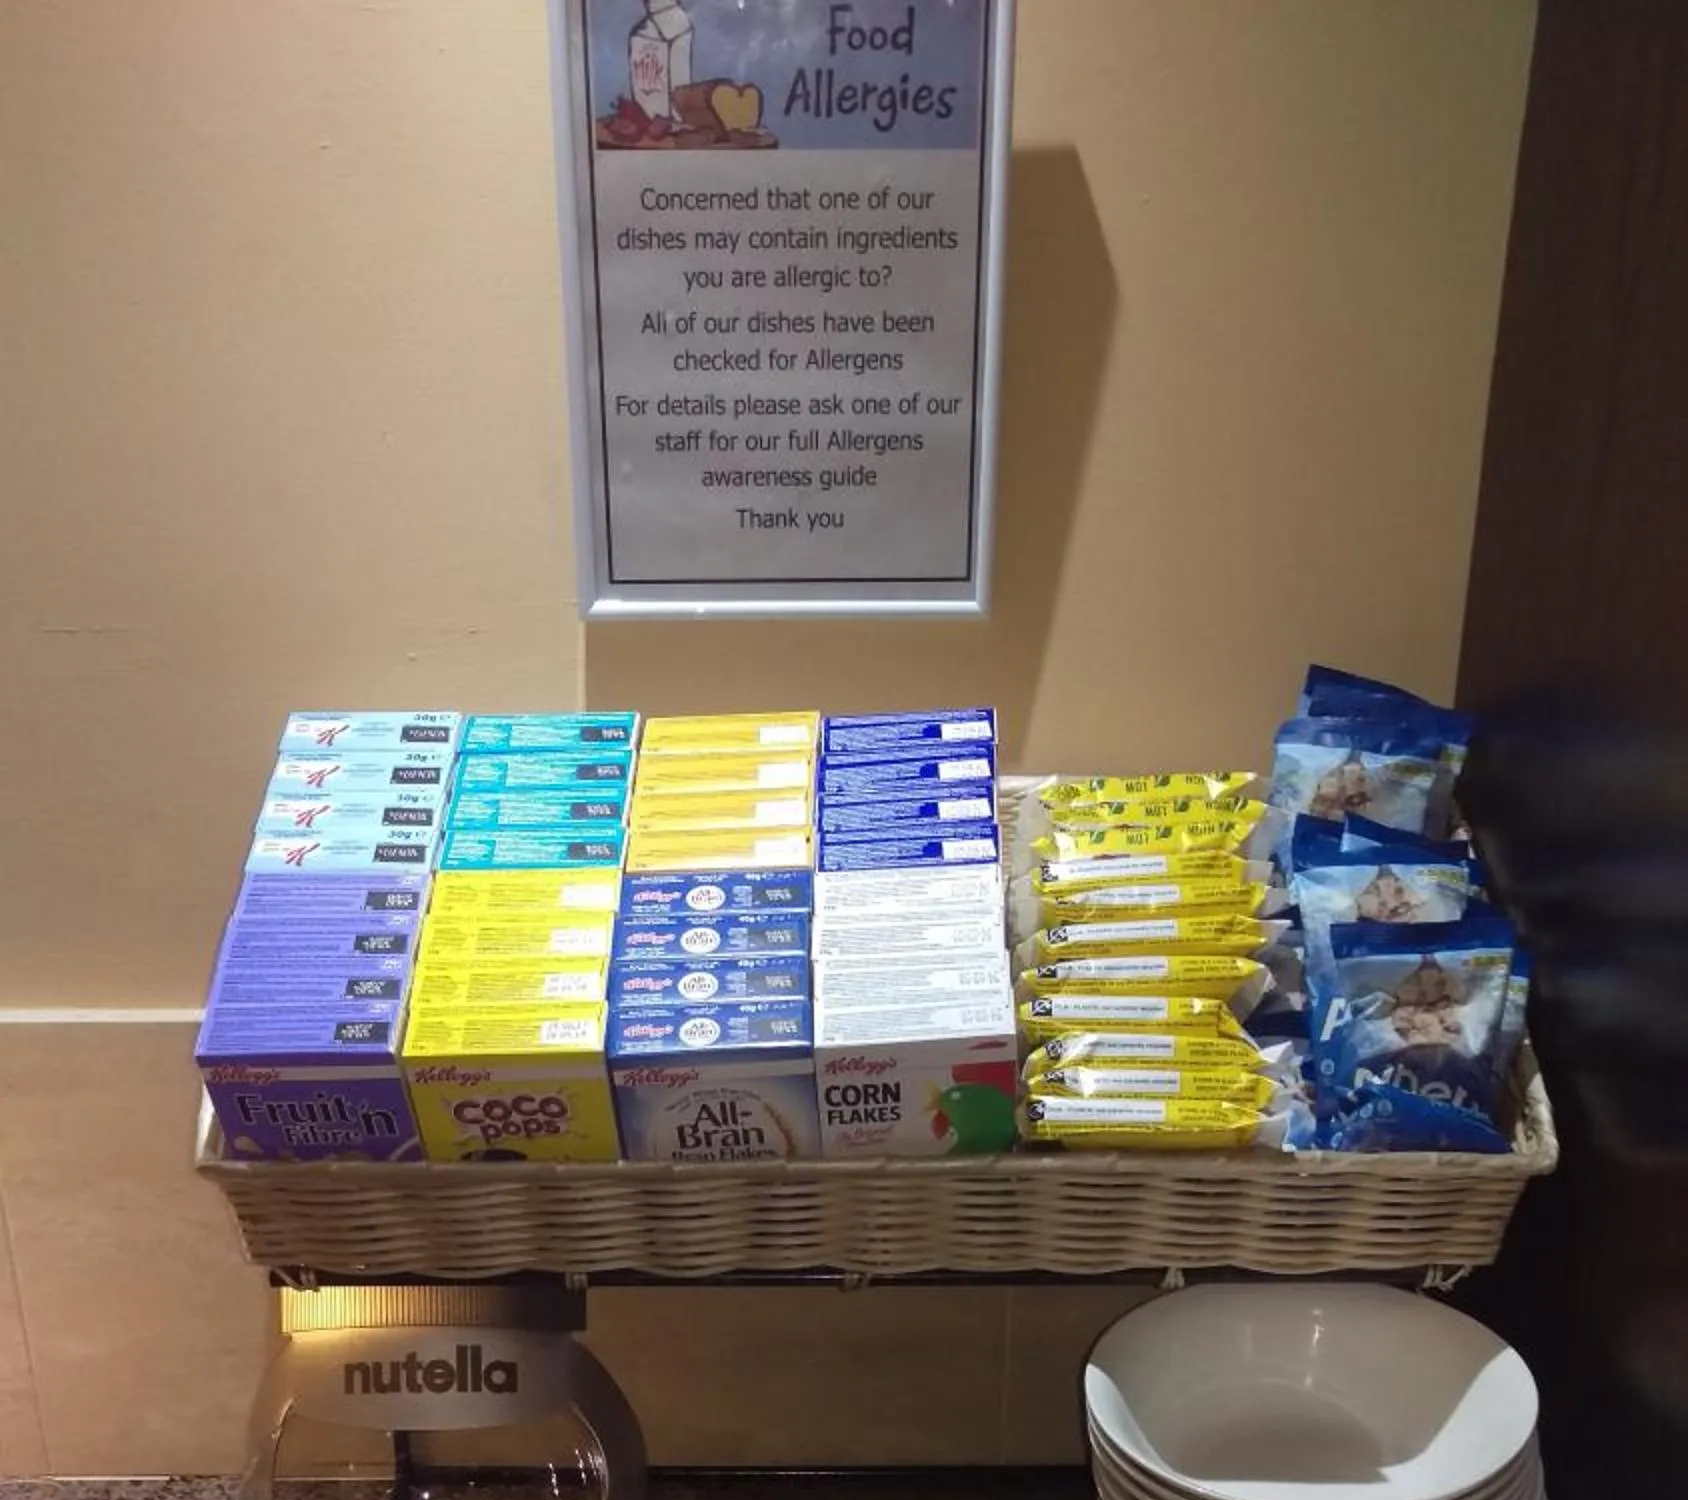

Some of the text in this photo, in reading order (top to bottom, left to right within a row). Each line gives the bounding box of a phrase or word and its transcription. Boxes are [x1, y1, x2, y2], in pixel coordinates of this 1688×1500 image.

[827, 3, 916, 56] Food
[783, 67, 957, 133] Allergies
[639, 185, 935, 212] Concerned that one of our
[616, 225, 959, 255] dishes may contain ingredients
[682, 264, 893, 294] you are allergic to?
[640, 310, 935, 335] All of our dishes have been
[673, 348, 904, 376] checked for Allergens
[615, 392, 962, 420] For details please ask one of our
[655, 429, 924, 457] staff for our full Allergens
[701, 465, 878, 491] awareness guide
[735, 507, 845, 533] Thank you
[415, 1065, 491, 1086] Kellogg's
[623, 1068, 700, 1088] Kellogg's
[824, 1056, 897, 1075] Kellogg's
[824, 1081, 901, 1107] CORN
[234, 1092, 351, 1124] Fruit
[695, 1101, 752, 1127] All-
[827, 1106, 901, 1125] FLAKES
[480, 1118, 560, 1144] pops
[676, 1123, 765, 1150] Bran
[343, 1344, 519, 1396] nutella
